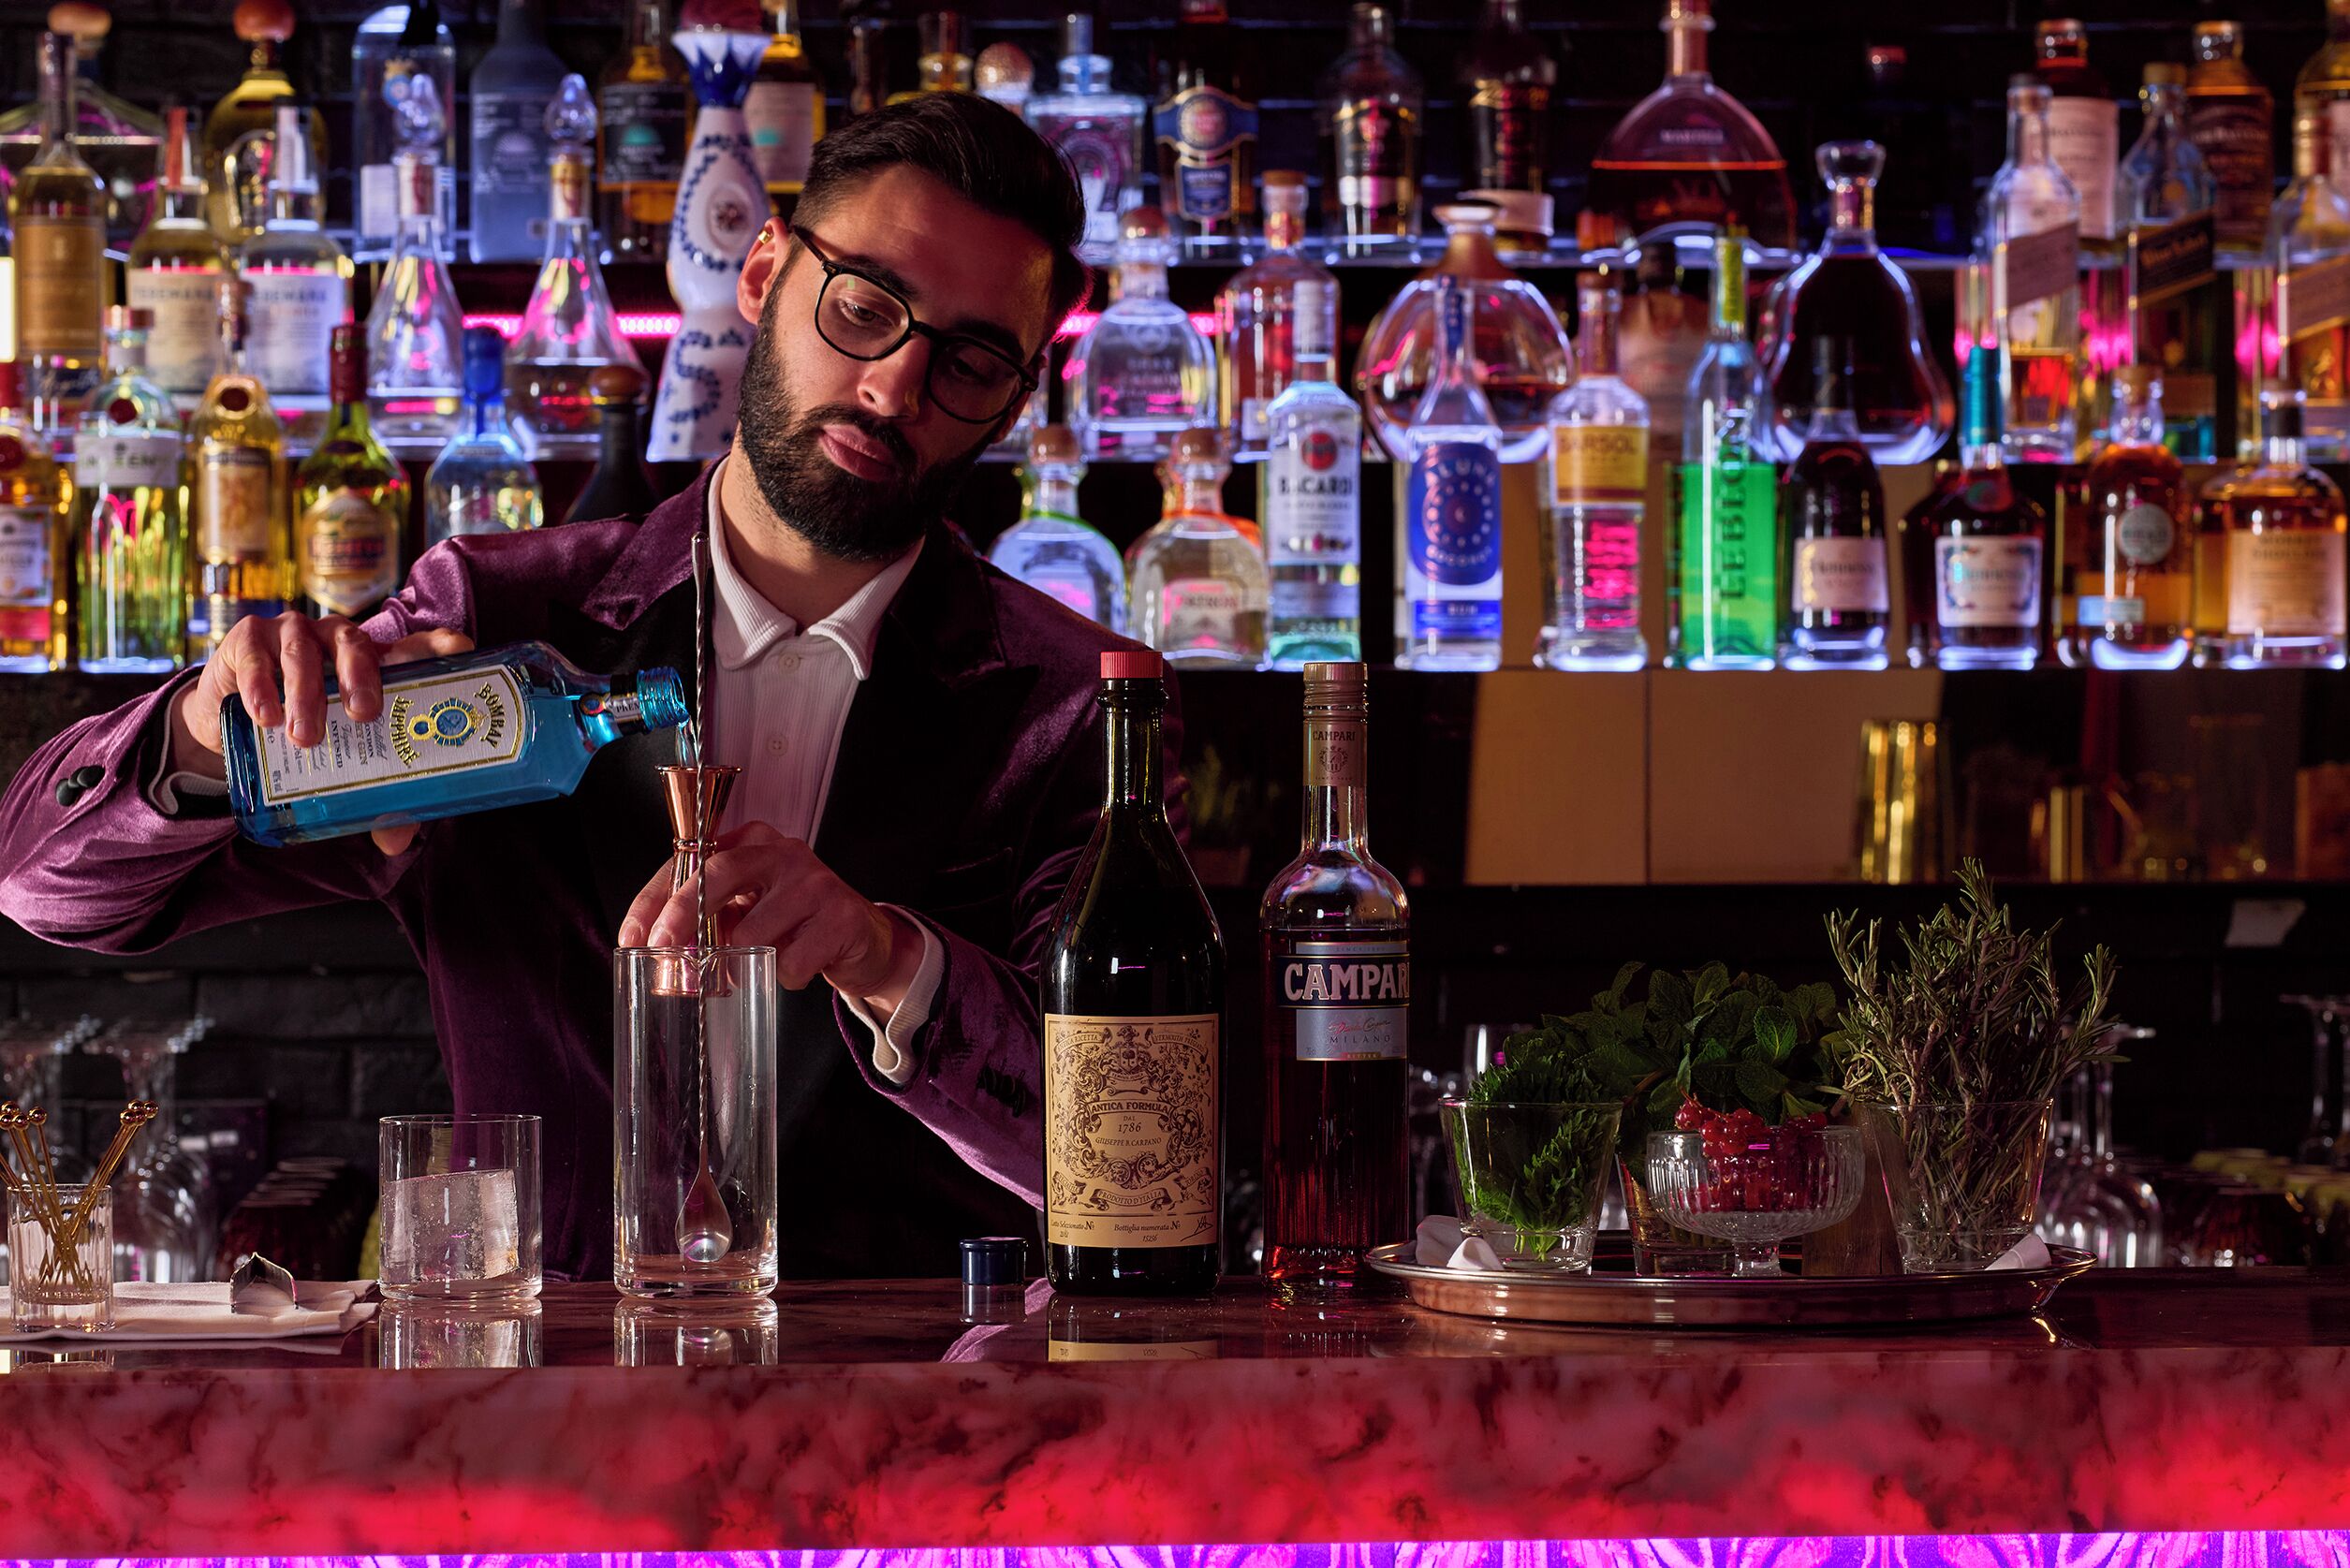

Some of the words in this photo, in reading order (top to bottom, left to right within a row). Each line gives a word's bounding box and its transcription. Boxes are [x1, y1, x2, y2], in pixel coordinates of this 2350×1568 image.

[474, 681, 506, 748] BOMBAY
[389, 695, 421, 766] SAPPHIRE
[1313, 731, 1356, 741] CAMPARI
[330, 720, 344, 769] INFUSED
[364, 722, 375, 758] ONDON
[357, 740, 369, 766] GIN
[1285, 962, 1410, 1002] CAMPAR
[1074, 1033, 1098, 1043] RICETTA
[1329, 1034, 1391, 1044] MILANO
[1092, 1101, 1124, 1113] ANTICA
[1125, 1101, 1168, 1114] FORMULA
[1118, 1121, 1141, 1134] 1786
[1094, 1136, 1124, 1147] GIUSEPPE
[1131, 1136, 1162, 1147] CARPANO
[1098, 1191, 1133, 1205] PRODOTTO
[1059, 1221, 1084, 1230] Selezionato
[1114, 1224, 1139, 1235] Bottiglia
